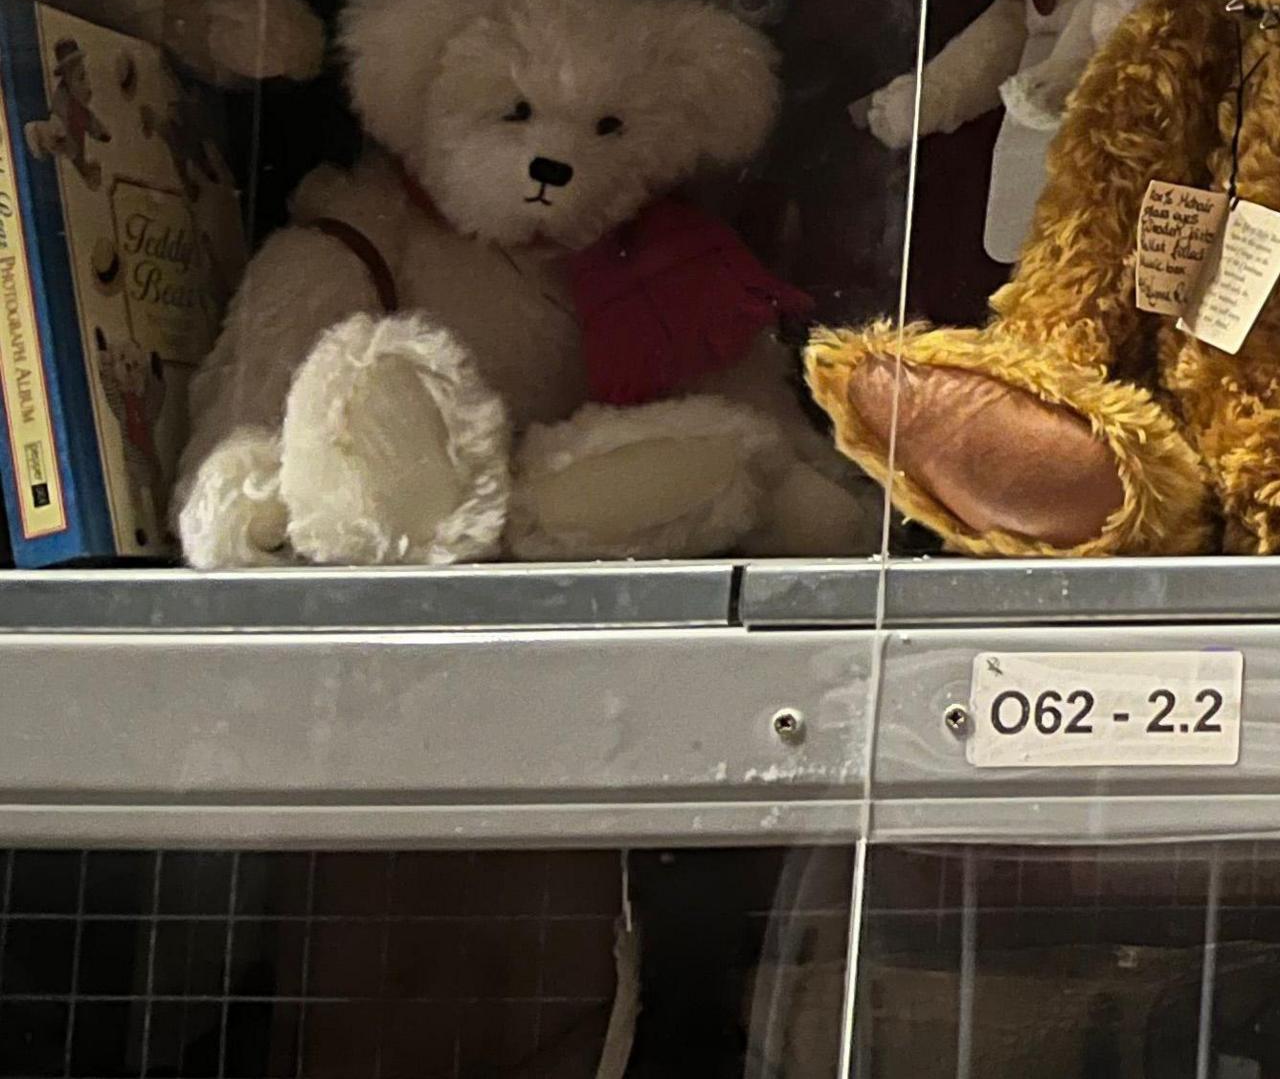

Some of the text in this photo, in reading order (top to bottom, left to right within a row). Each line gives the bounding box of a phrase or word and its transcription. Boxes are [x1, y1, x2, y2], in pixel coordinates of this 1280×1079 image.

[0, 256, 26, 362] PHOTOGRAPH
[15, 365, 36, 424] ALBUM
[990, 688, 1223, 735] O62 - 2.2
